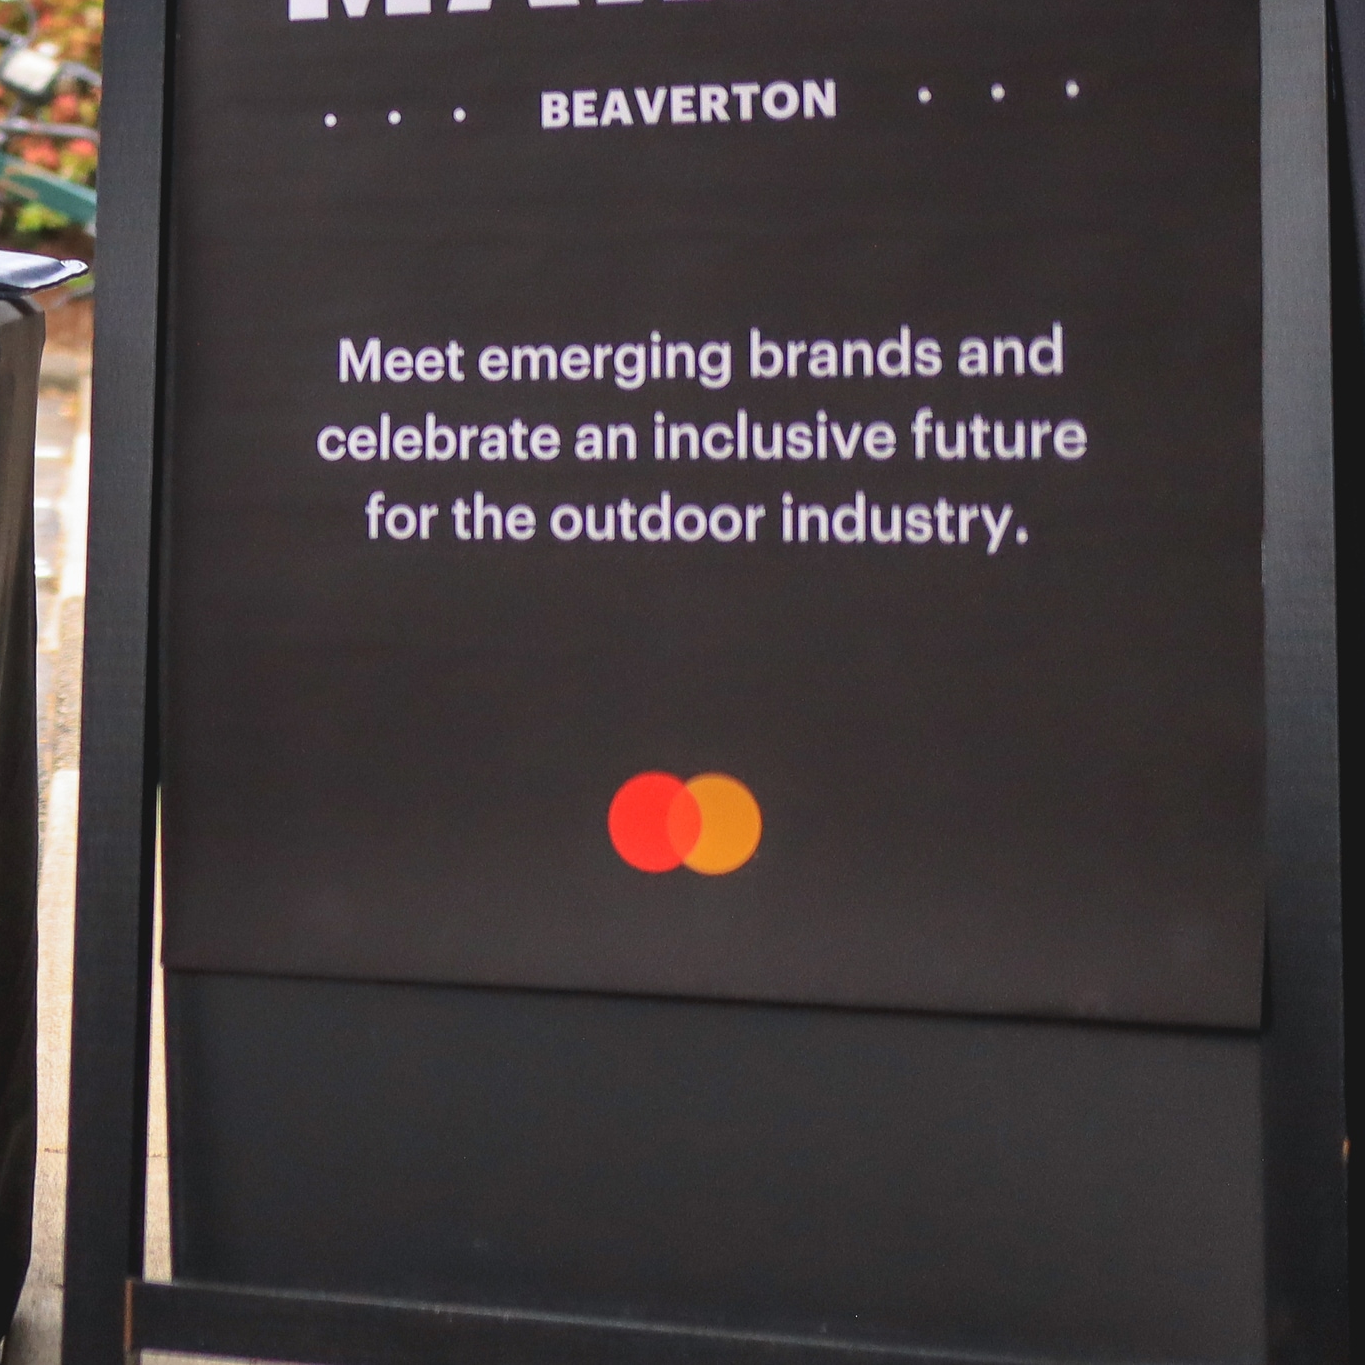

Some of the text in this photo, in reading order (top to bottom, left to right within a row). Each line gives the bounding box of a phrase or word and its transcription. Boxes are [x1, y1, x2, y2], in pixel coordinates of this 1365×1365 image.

[540, 79, 838, 131] BEAVERTON
[337, 323, 1065, 390] Meet emerging brands and
[316, 406, 1089, 463] celebrate an inclusive future
[364, 490, 1030, 554] for the outdoor industry.
